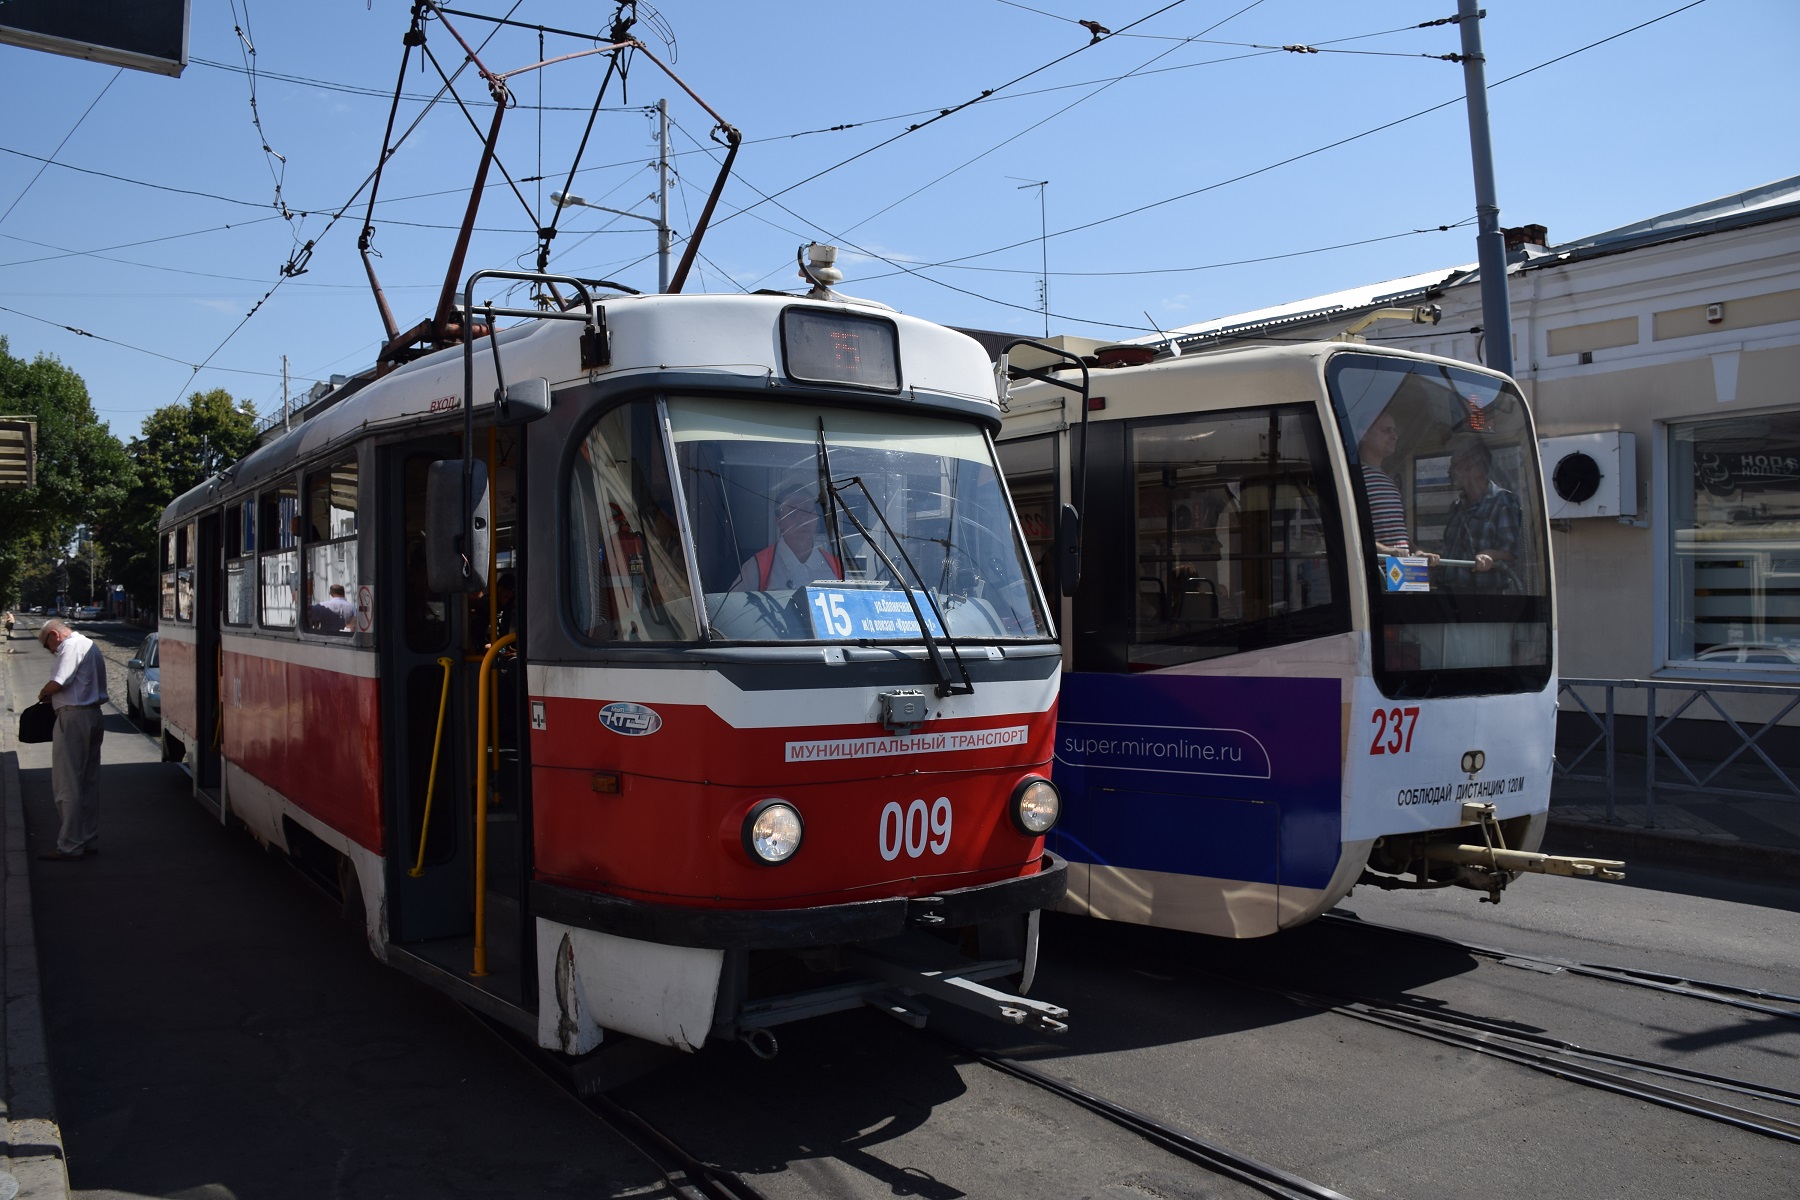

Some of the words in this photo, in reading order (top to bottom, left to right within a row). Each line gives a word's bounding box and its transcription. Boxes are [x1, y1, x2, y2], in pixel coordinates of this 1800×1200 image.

[430, 397, 455, 412] ВХОД
[815, 593, 852, 636] 15
[791, 733, 946, 759] МУНИЦИПАЛЬНЫЙ
[950, 729, 1025, 748] ТРАНСПОРТ
[1369, 706, 1420, 755] 237
[1065, 737, 1242, 762] super.mironline.ru
[1397, 783, 1453, 806] СОБЛЮДАЙ
[1454, 779, 1505, 803] ДИСТАНЦИЮ
[879, 796, 952, 861] 009
